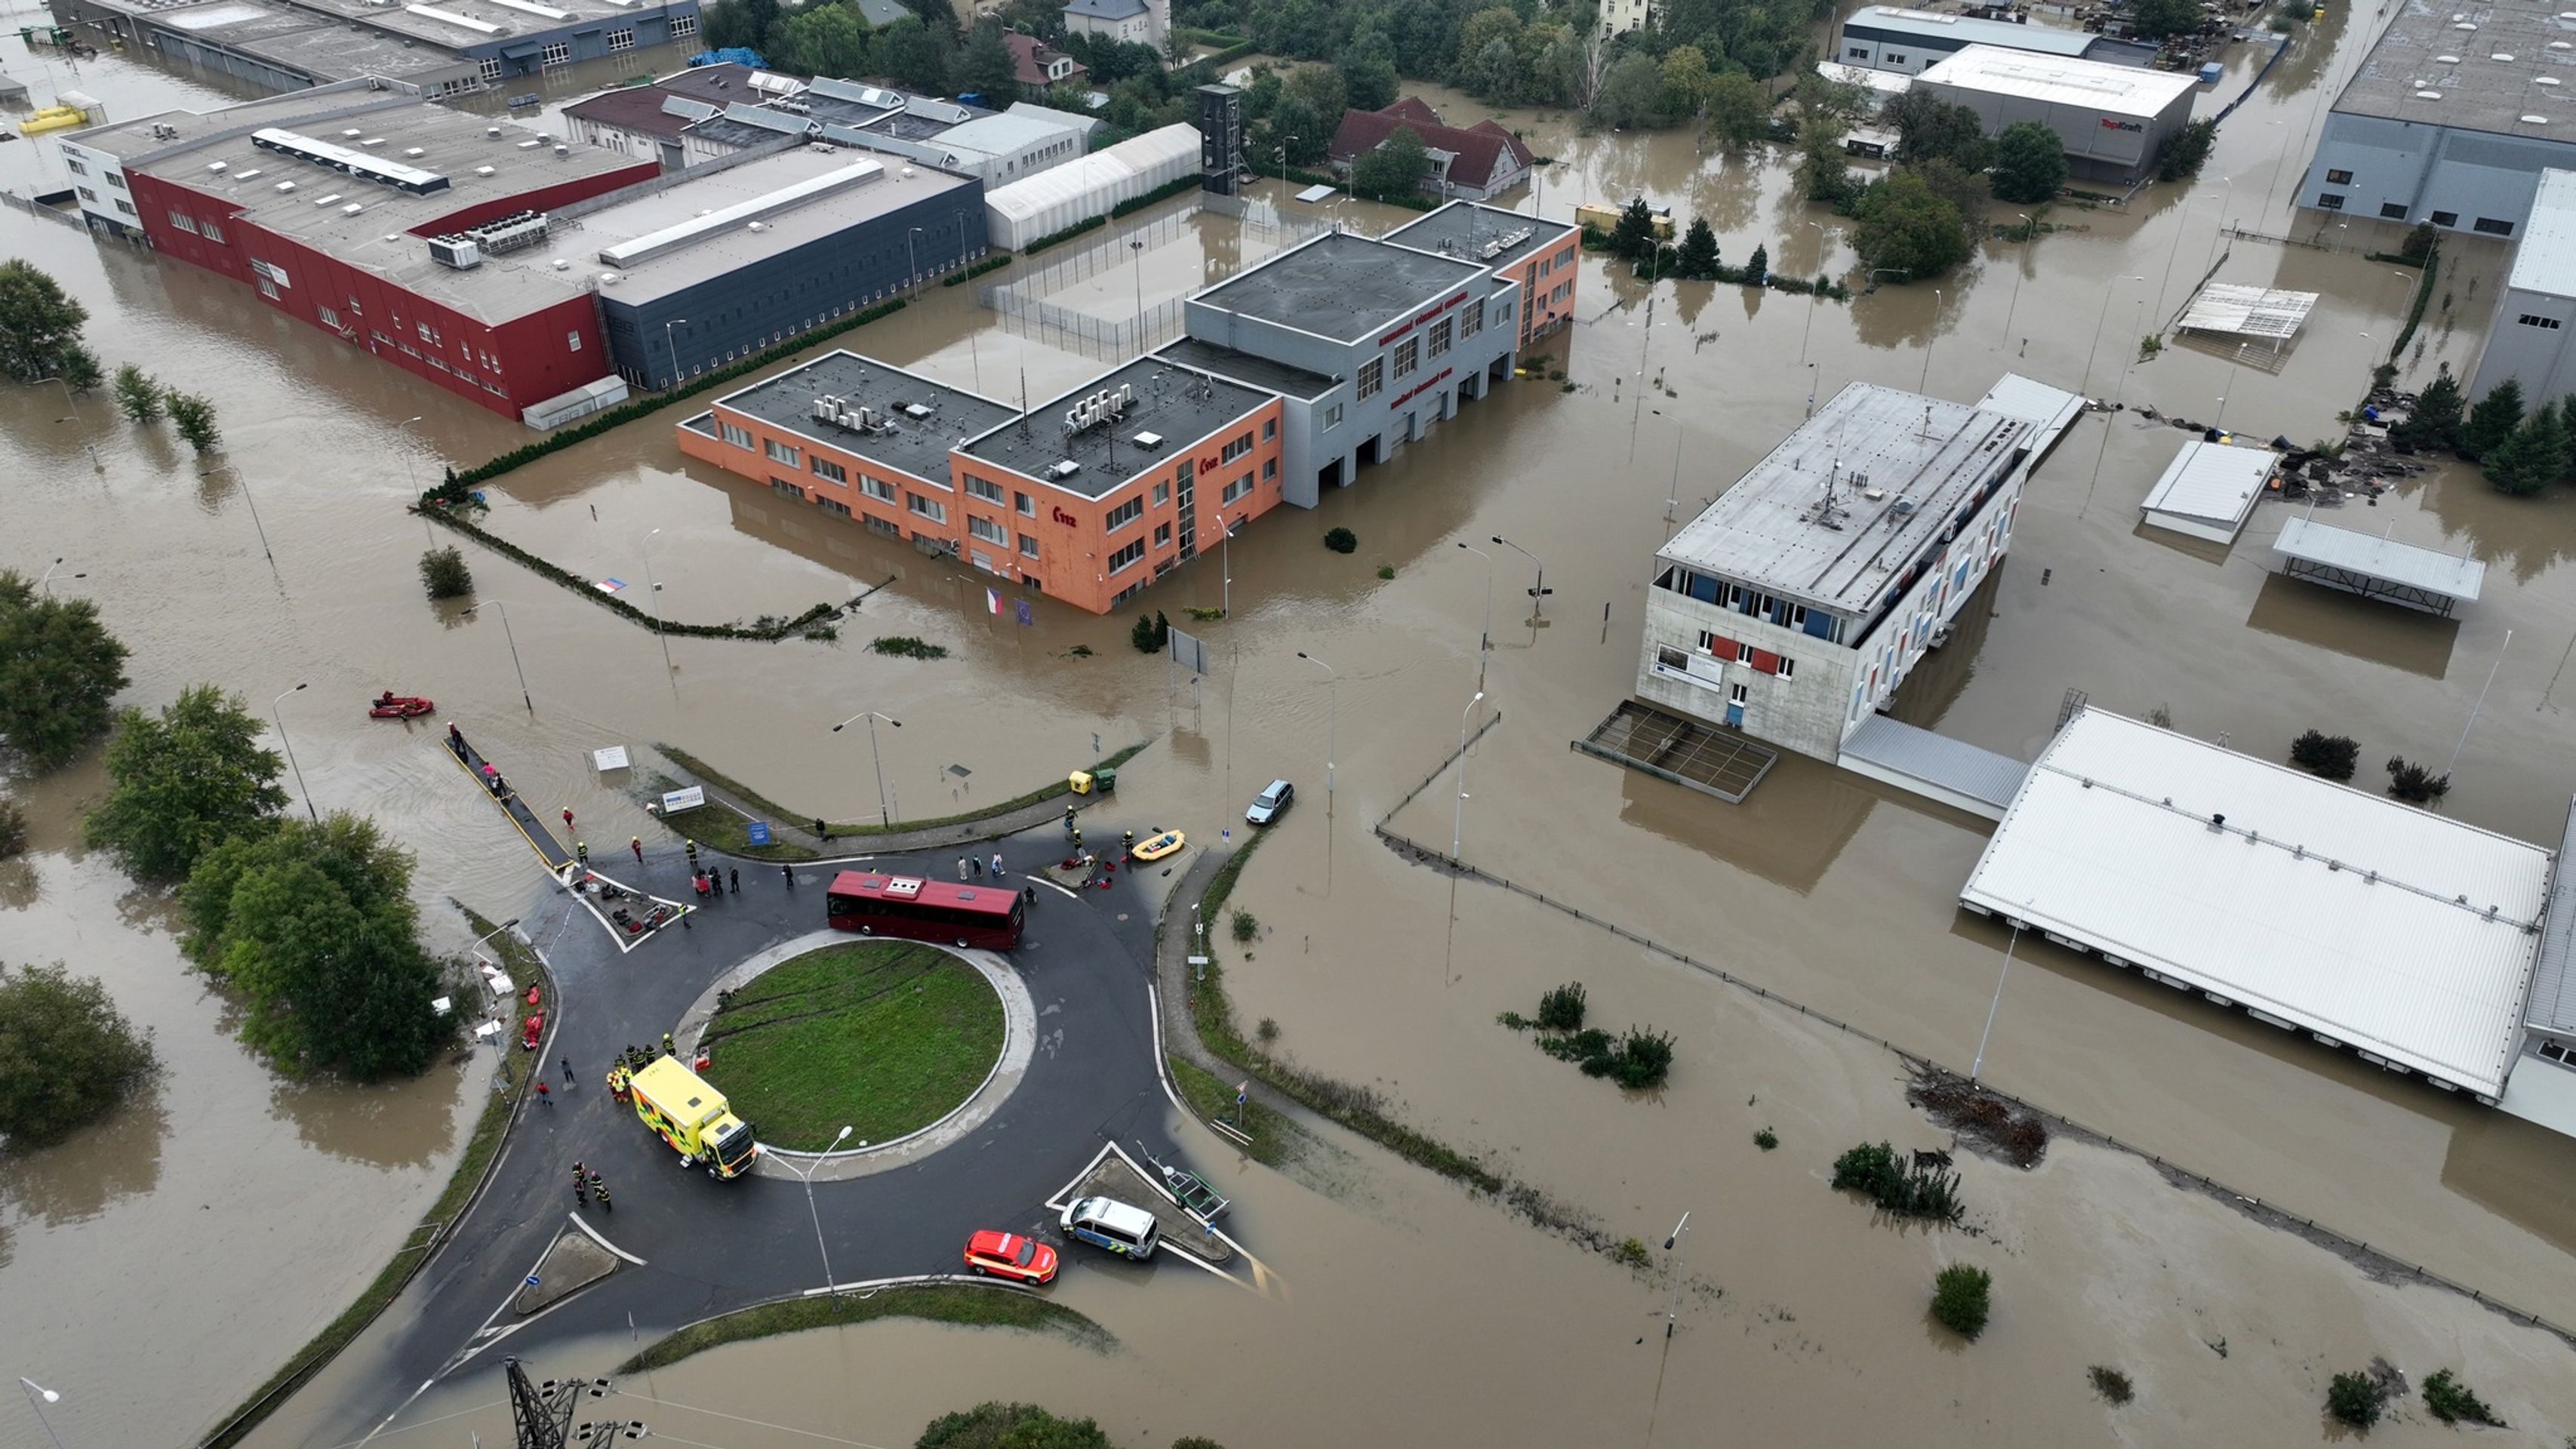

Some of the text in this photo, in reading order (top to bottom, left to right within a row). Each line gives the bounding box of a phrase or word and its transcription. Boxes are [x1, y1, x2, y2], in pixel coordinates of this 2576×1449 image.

[2101, 118, 2144, 134] TopKraft
[1205, 457, 1218, 472] 112
[1059, 513, 1076, 528] 112
